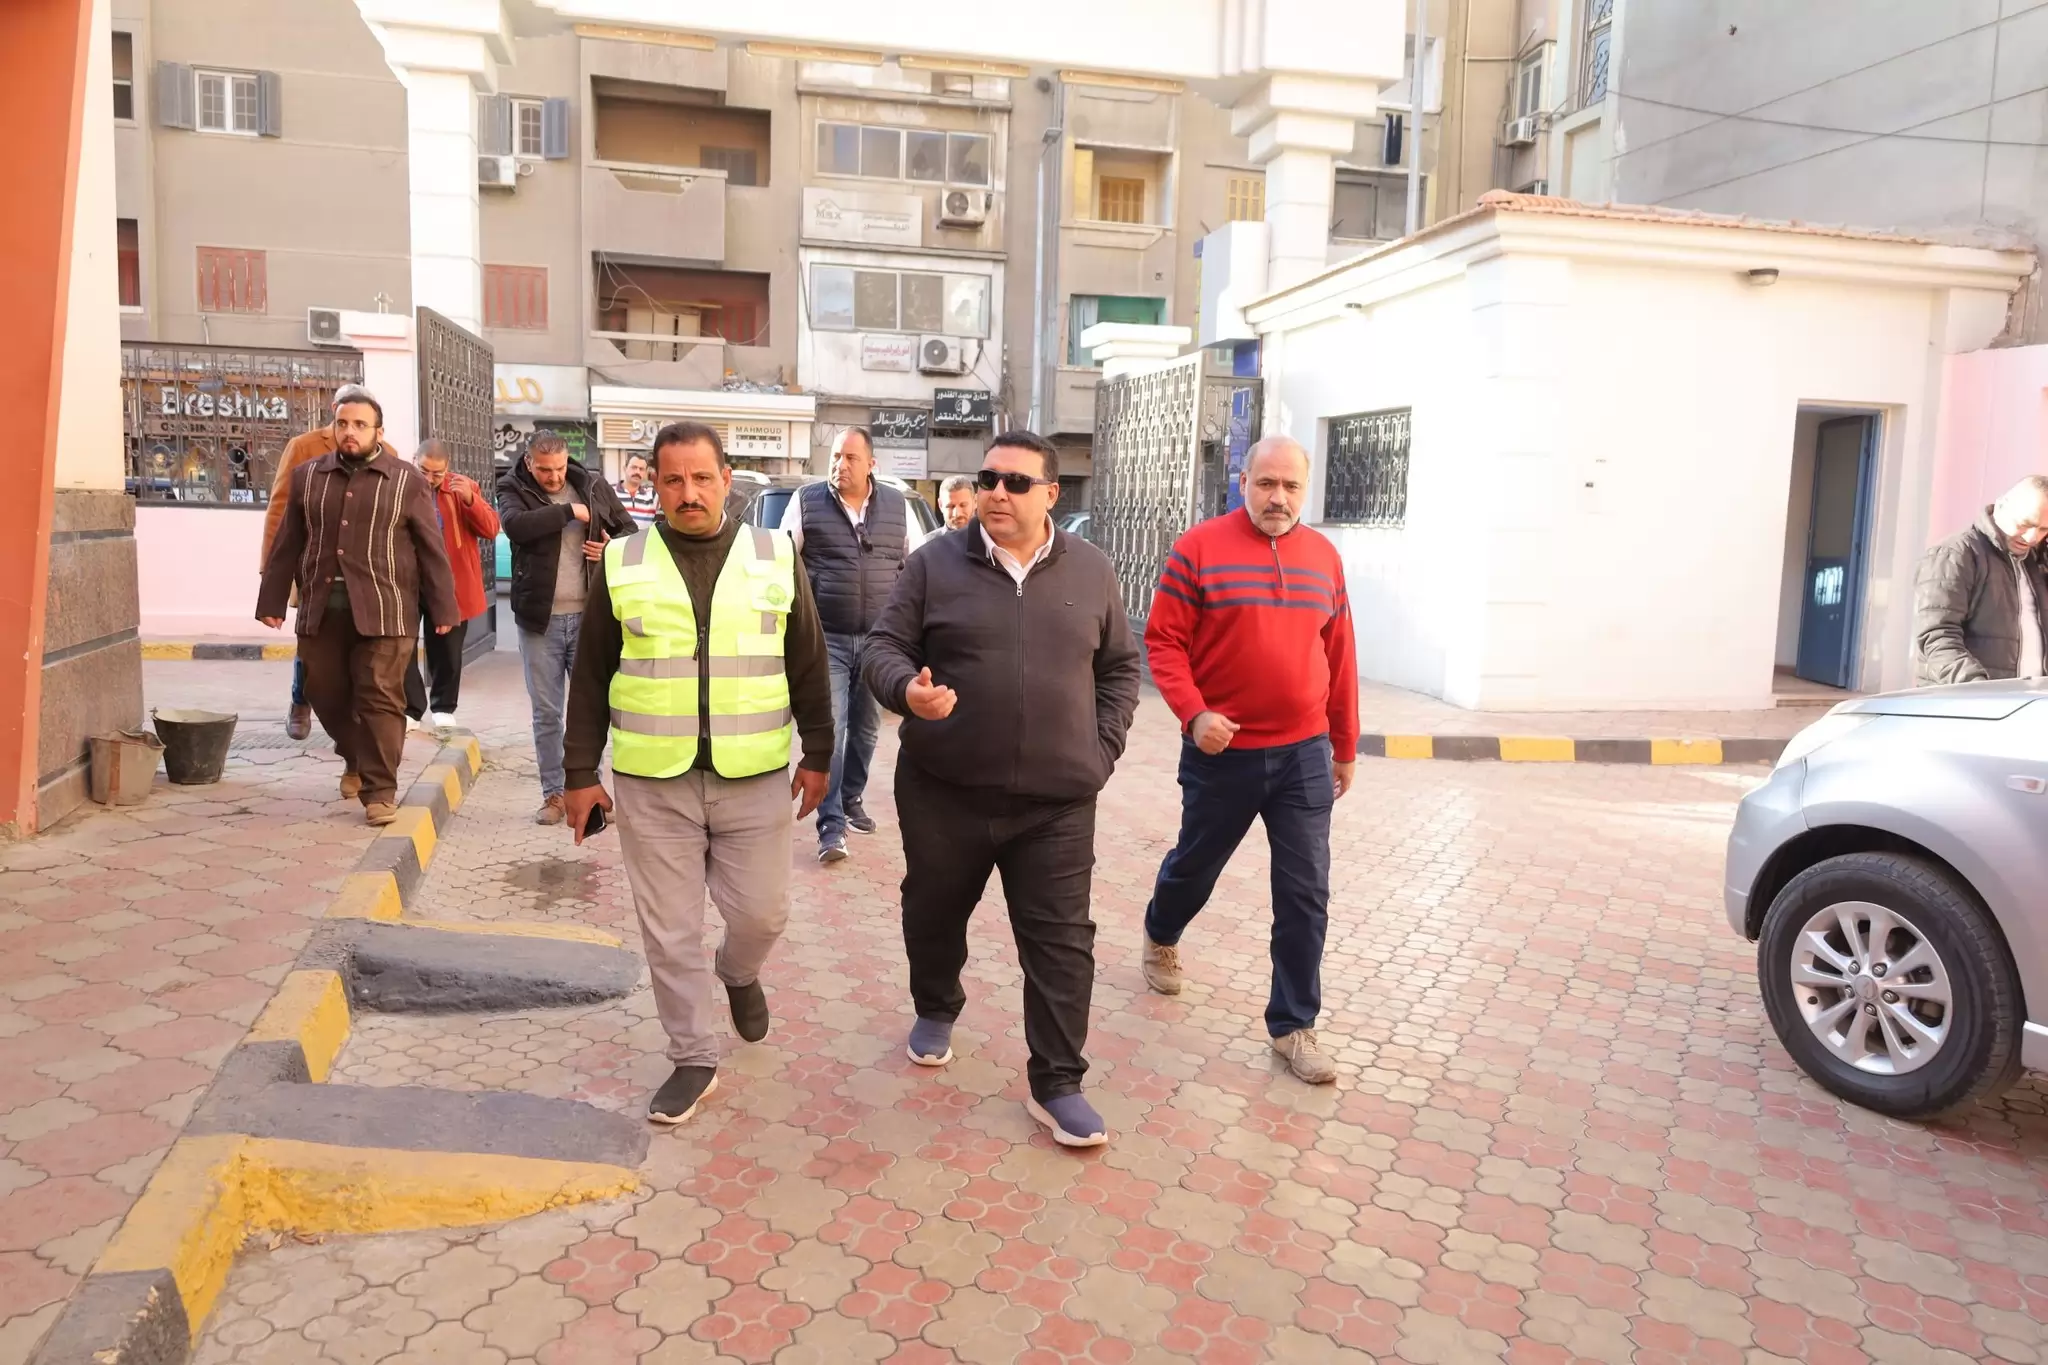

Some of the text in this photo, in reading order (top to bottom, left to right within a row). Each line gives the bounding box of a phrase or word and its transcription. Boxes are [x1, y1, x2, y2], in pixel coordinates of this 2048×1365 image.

[160, 386, 289, 419] Breshka
[934, 411, 963, 424] بالنقض
[735, 425, 783, 434] MAHMOUD
